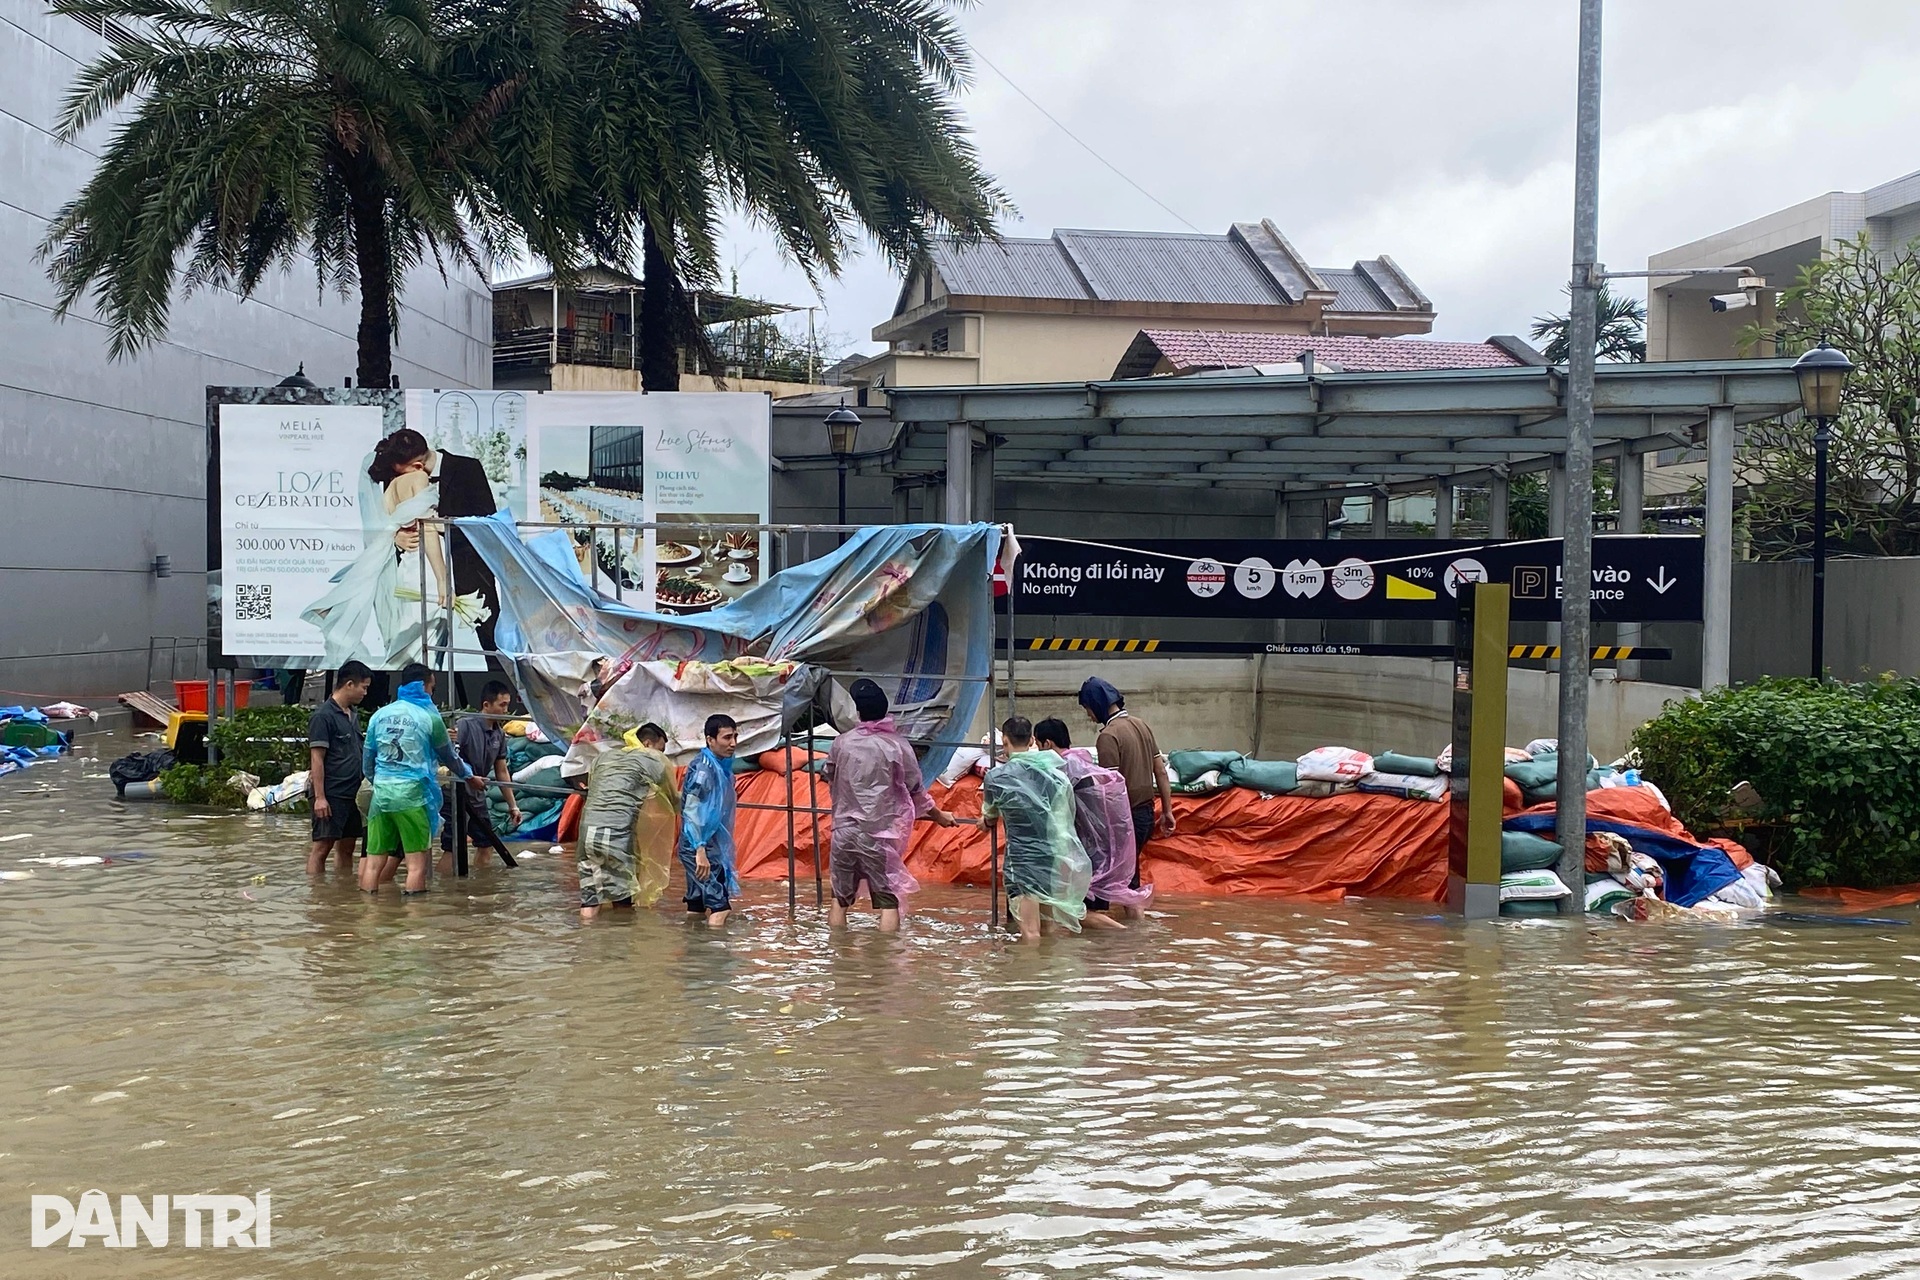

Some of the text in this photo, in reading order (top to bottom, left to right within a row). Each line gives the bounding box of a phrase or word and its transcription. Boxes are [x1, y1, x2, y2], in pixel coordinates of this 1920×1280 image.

[655, 429, 735, 454] Love Stories
[277, 470, 344, 494] LOVE
[656, 471, 700, 482] DỊCH VỤ
[235, 492, 354, 509] CELEBRATION
[235, 521, 249, 530] Chỉ
[236, 538, 285, 551] 300.000
[289, 538, 324, 551] VNĐ
[331, 543, 356, 552] khách
[1023, 560, 1165, 583] Không đi lối này
[1248, 568, 1261, 584] 5
[1343, 566, 1363, 577] 3m
[1405, 567, 1434, 579] 10%
[1592, 566, 1631, 583] vào
[1289, 574, 1317, 585] 1,9m
[1022, 582, 1077, 597] No entry
[1265, 643, 1291, 653] Chiều
[1311, 644, 1324, 653] tối
[1325, 645, 1337, 653] đa
[1339, 645, 1361, 655] 1,9m
